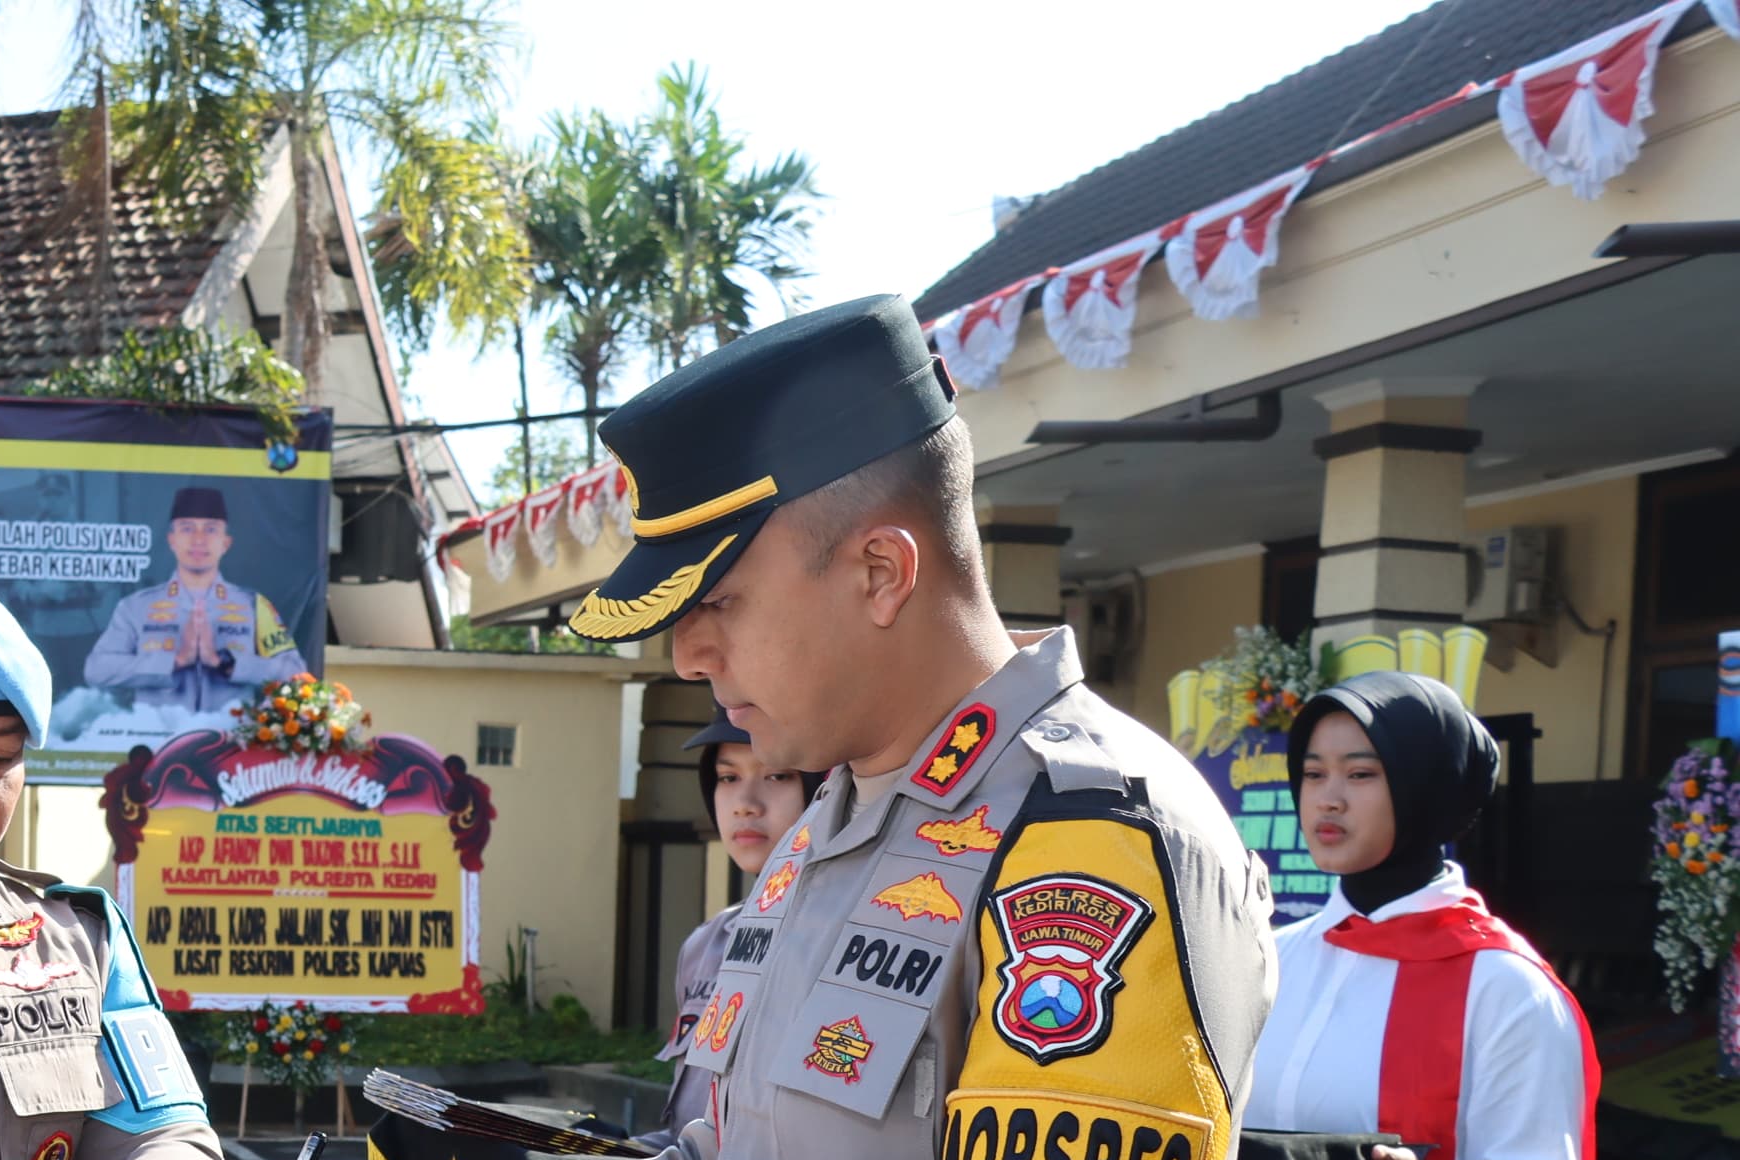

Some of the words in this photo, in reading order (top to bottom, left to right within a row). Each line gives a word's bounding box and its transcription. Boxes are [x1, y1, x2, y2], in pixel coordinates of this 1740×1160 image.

[41, 523, 98, 549] POLISI
[101, 525, 150, 550] YANG
[217, 753, 300, 807] Selamat
[315, 754, 389, 807] Sukses
[216, 814, 258, 834] ATAS
[179, 836, 205, 865] AKP
[162, 867, 280, 886] KASATLANTAS
[290, 869, 375, 888] POLRESTA
[383, 871, 437, 890] KEDIRI
[1014, 888, 1123, 917] POLRES
[1014, 899, 1071, 921] KEDIRI
[1075, 900, 1117, 929] KOTA
[146, 906, 172, 945] AKP
[419, 910, 455, 949] ISTRI
[1020, 926, 1061, 943] JAWA
[1062, 926, 1105, 952] TIMUR
[173, 950, 222, 977] KASAT
[229, 950, 295, 977] RESKRIM
[303, 951, 360, 978] POLRES
[368, 952, 426, 979] KAPUAS
[835, 934, 943, 997] POLRI
